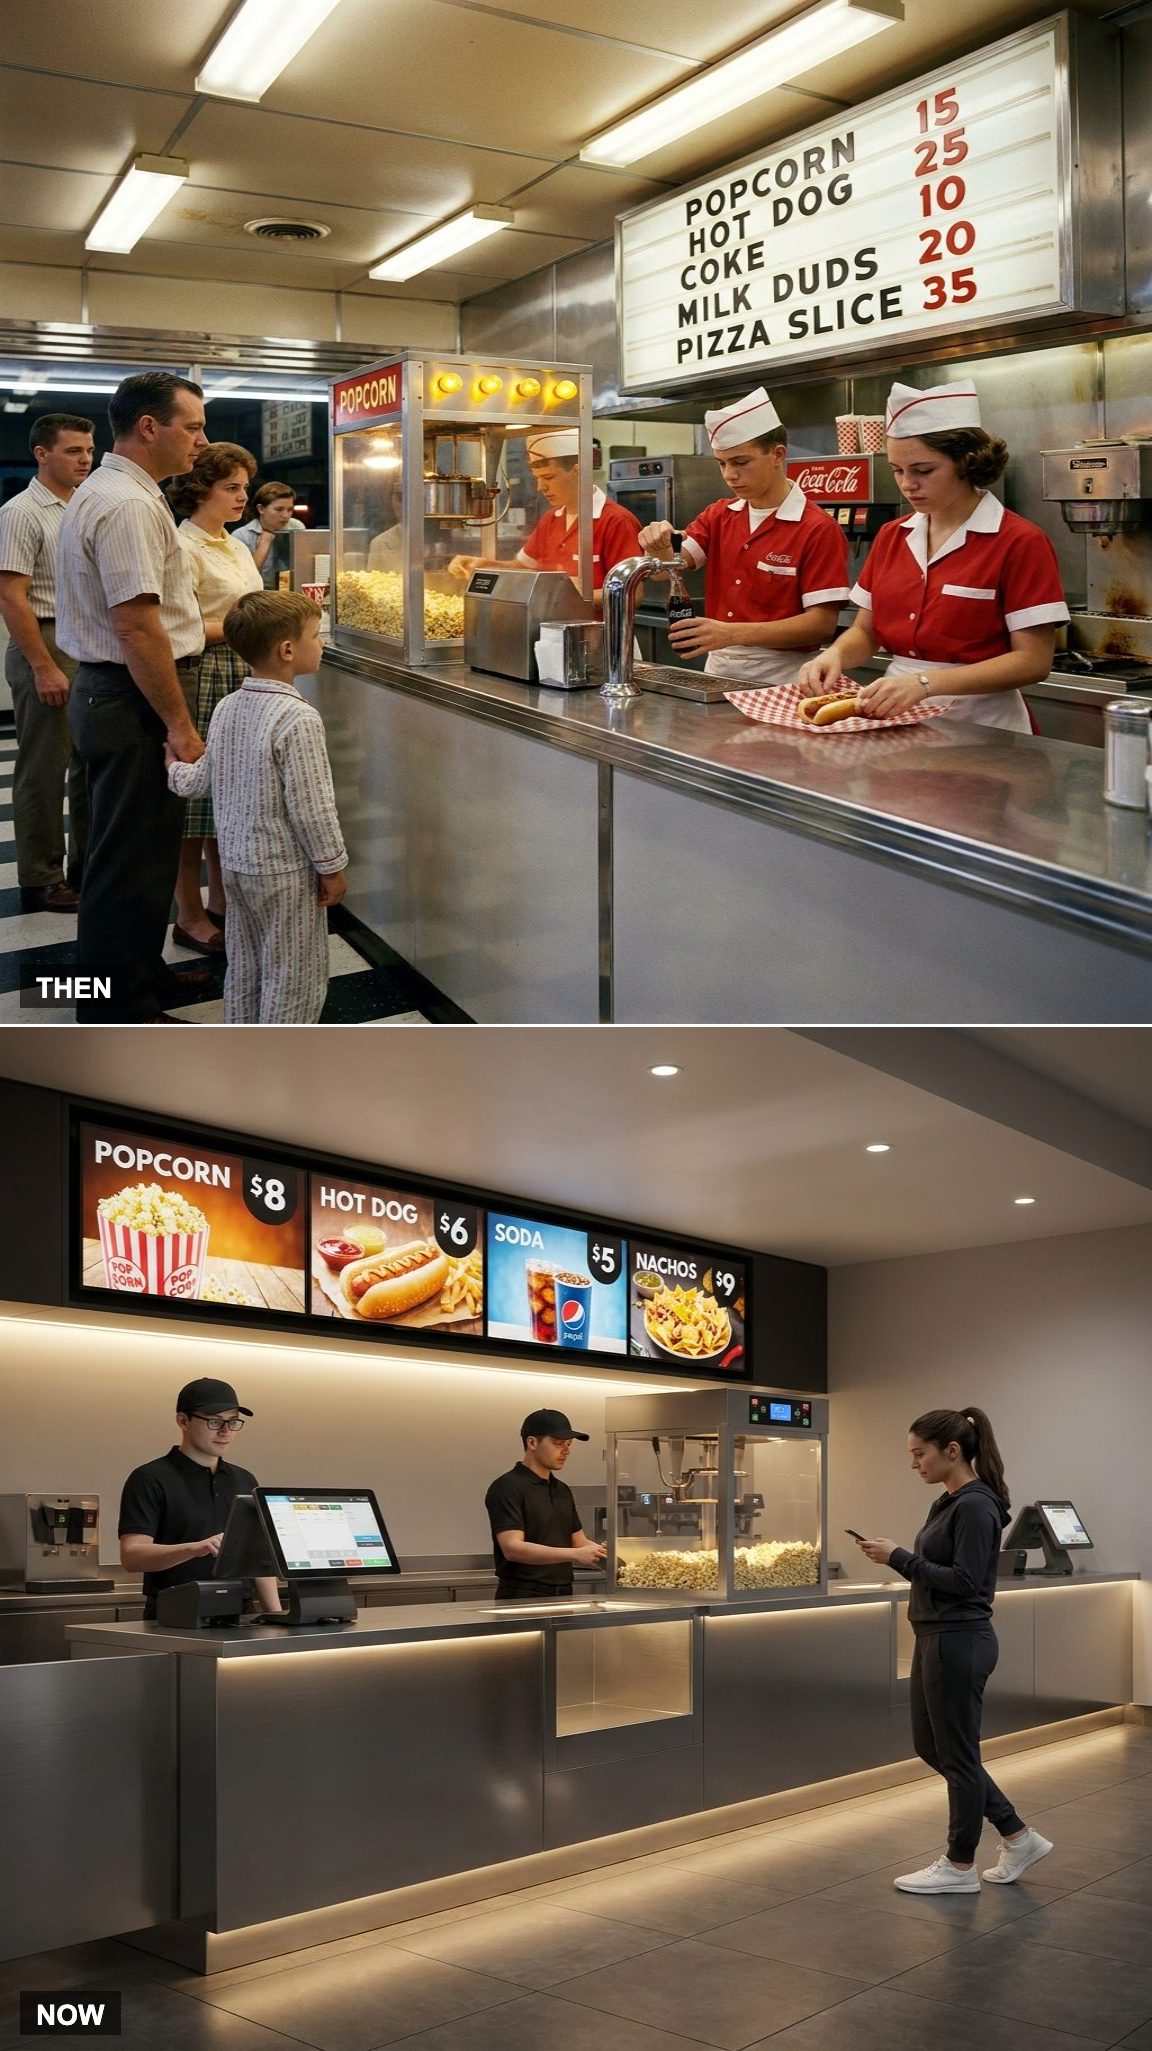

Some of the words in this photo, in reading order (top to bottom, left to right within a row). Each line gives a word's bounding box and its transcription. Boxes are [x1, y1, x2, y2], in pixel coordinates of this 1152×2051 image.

[686, 131, 856, 226] POPCORN
[916, 87, 959, 133] 15
[689, 210, 751, 257] HOT
[773, 173, 853, 227] DOG
[914, 127, 969, 177] 25
[680, 241, 765, 291] COKE
[919, 175, 966, 217] 10
[678, 283, 752, 328] MILK
[773, 247, 878, 303] DUDS
[919, 221, 976, 265] 20
[677, 319, 770, 364] PIZZA
[788, 284, 903, 340] SLICE
[923, 268, 978, 310] 35
[340, 374, 397, 414] POPCORN
[95, 1140, 231, 1188] POPCORN
[250, 1174, 286, 1211] $8
[320, 1186, 365, 1213] HOT
[372, 1200, 418, 1225] DOG
[440, 1212, 469, 1246] $6
[494, 1223, 544, 1249] SODA
[112, 1262, 132, 1274] POP
[592, 1243, 615, 1273] $5
[636, 1252, 697, 1280] NACHOS
[171, 1270, 192, 1285] POP
[715, 1270, 736, 1297] $9
